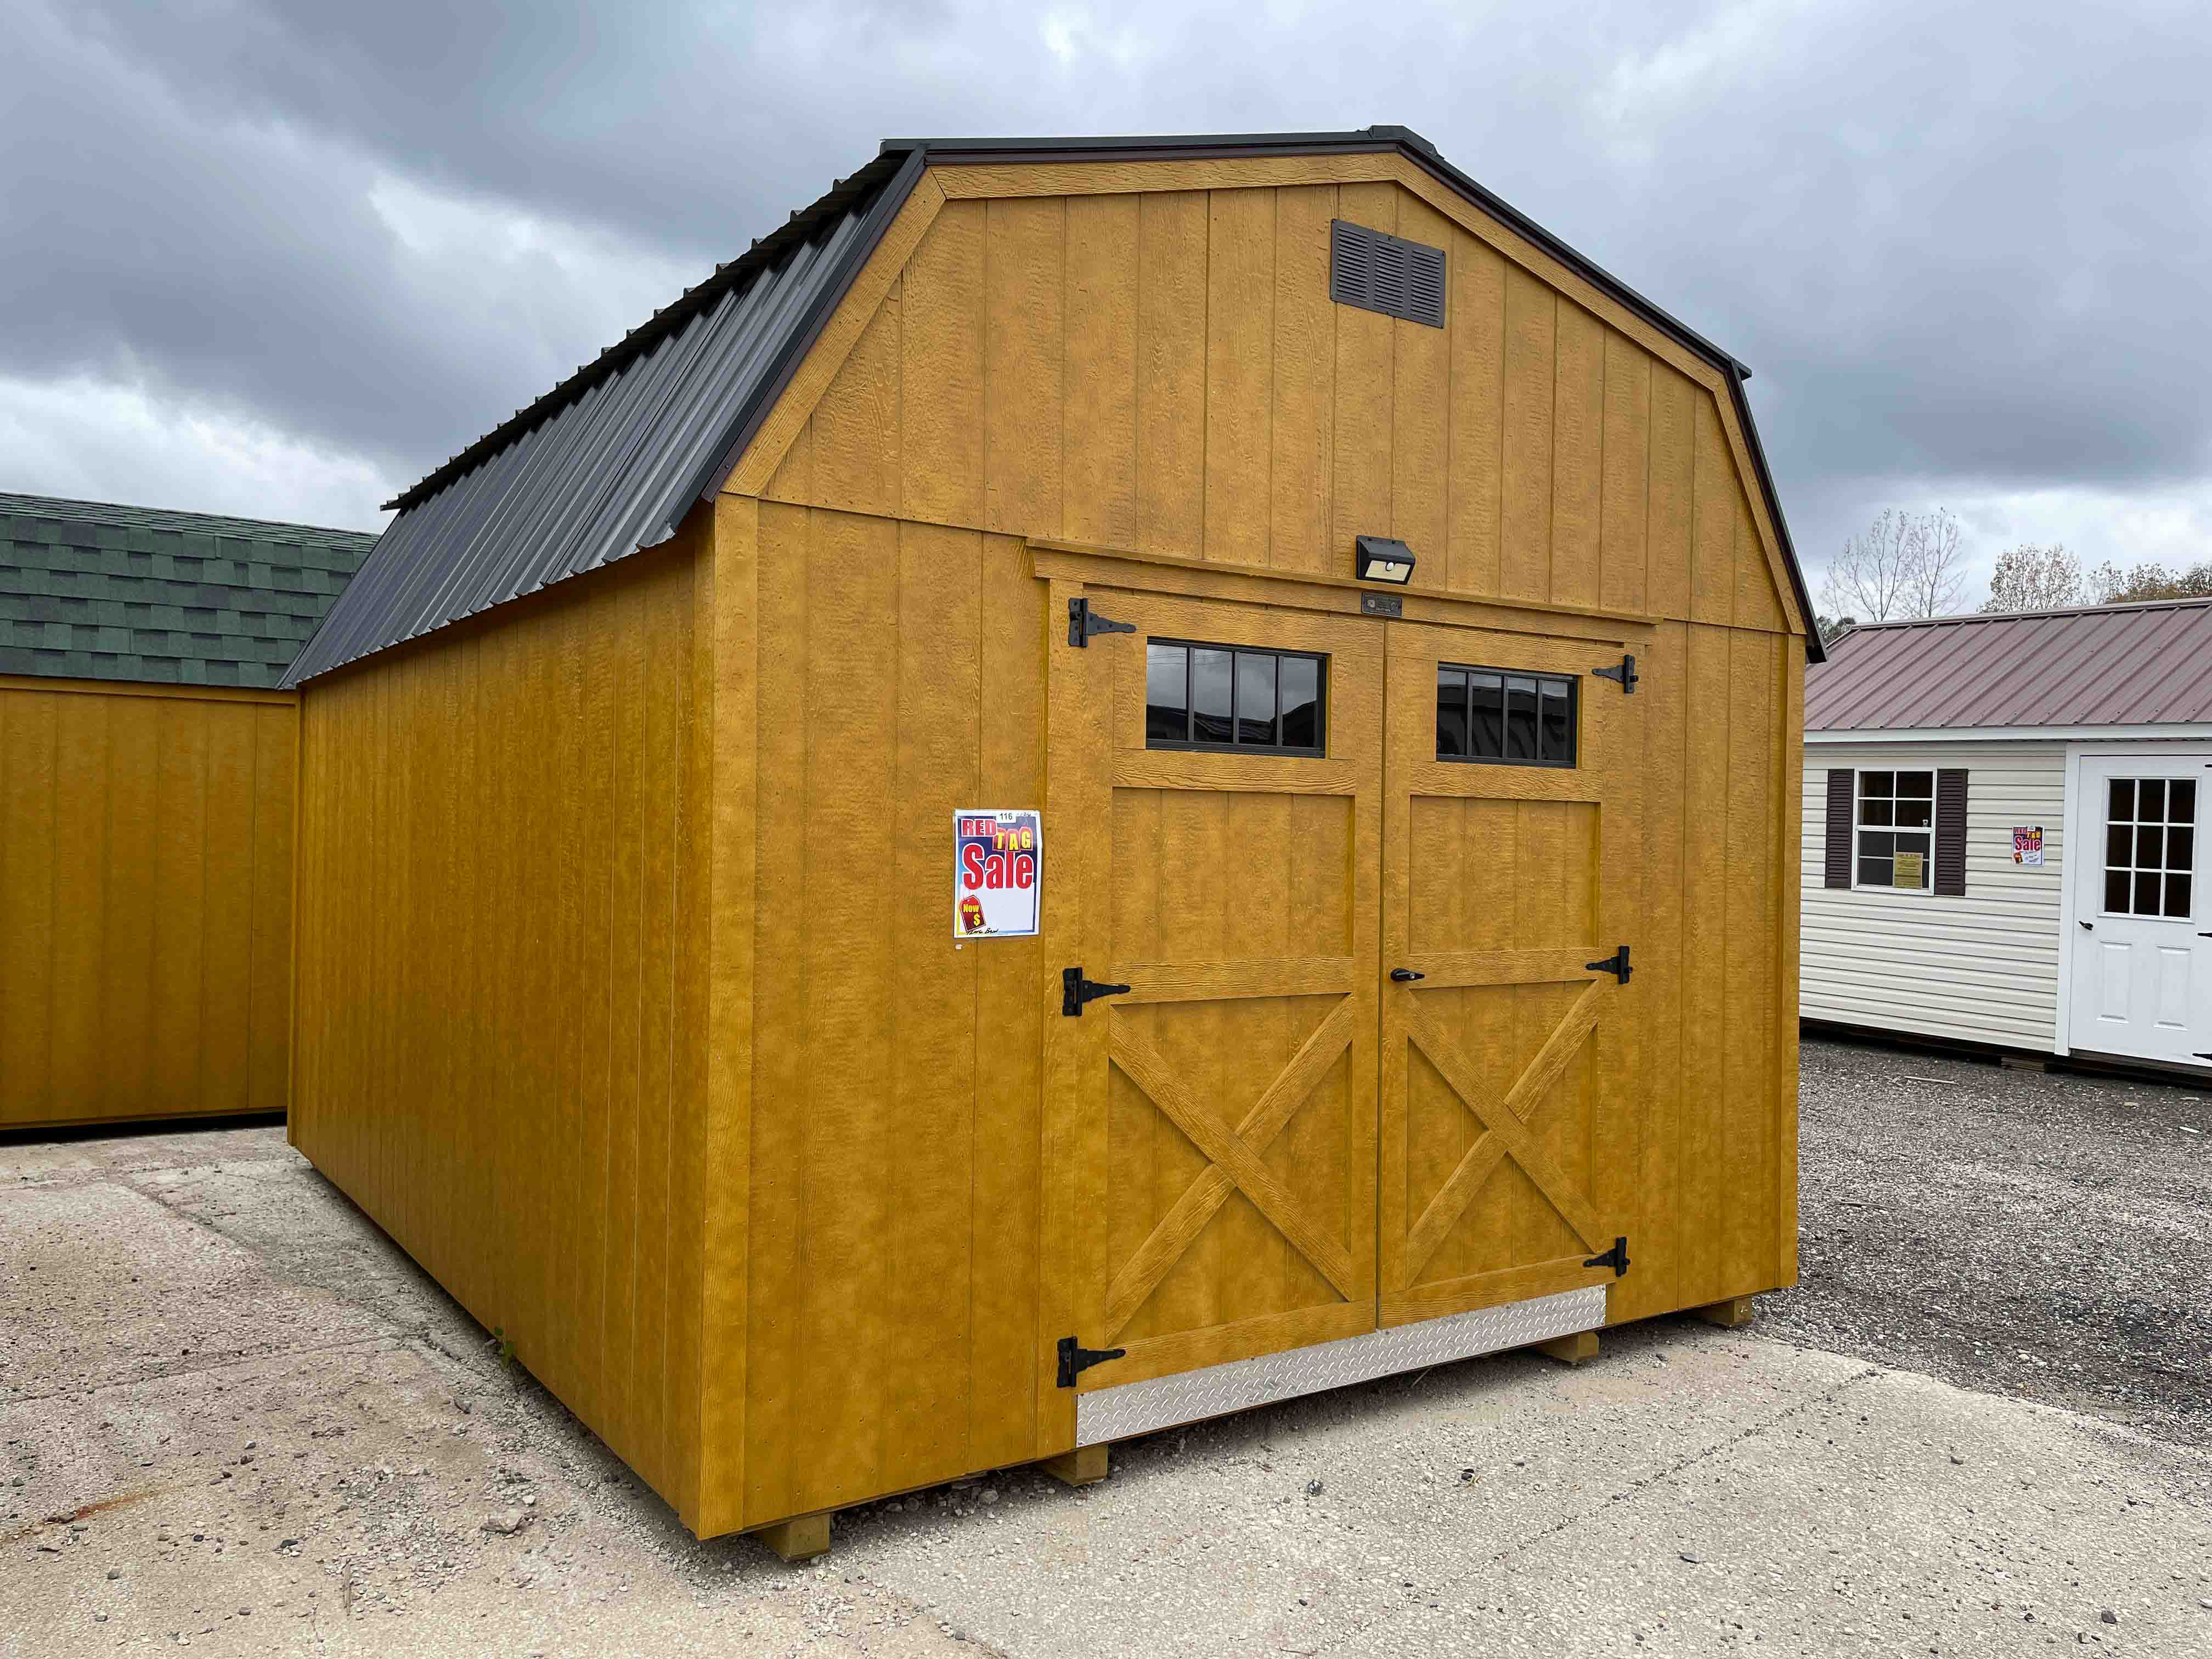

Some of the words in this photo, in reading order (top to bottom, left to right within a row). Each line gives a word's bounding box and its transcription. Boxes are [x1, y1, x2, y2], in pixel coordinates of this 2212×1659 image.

[1000, 812, 1013, 821] 116
[962, 819, 996, 837] RED
[995, 829, 1031, 850] TAG
[2015, 836, 2041, 851] Sale
[963, 844, 1033, 890] Sale
[973, 913, 980, 926] $
